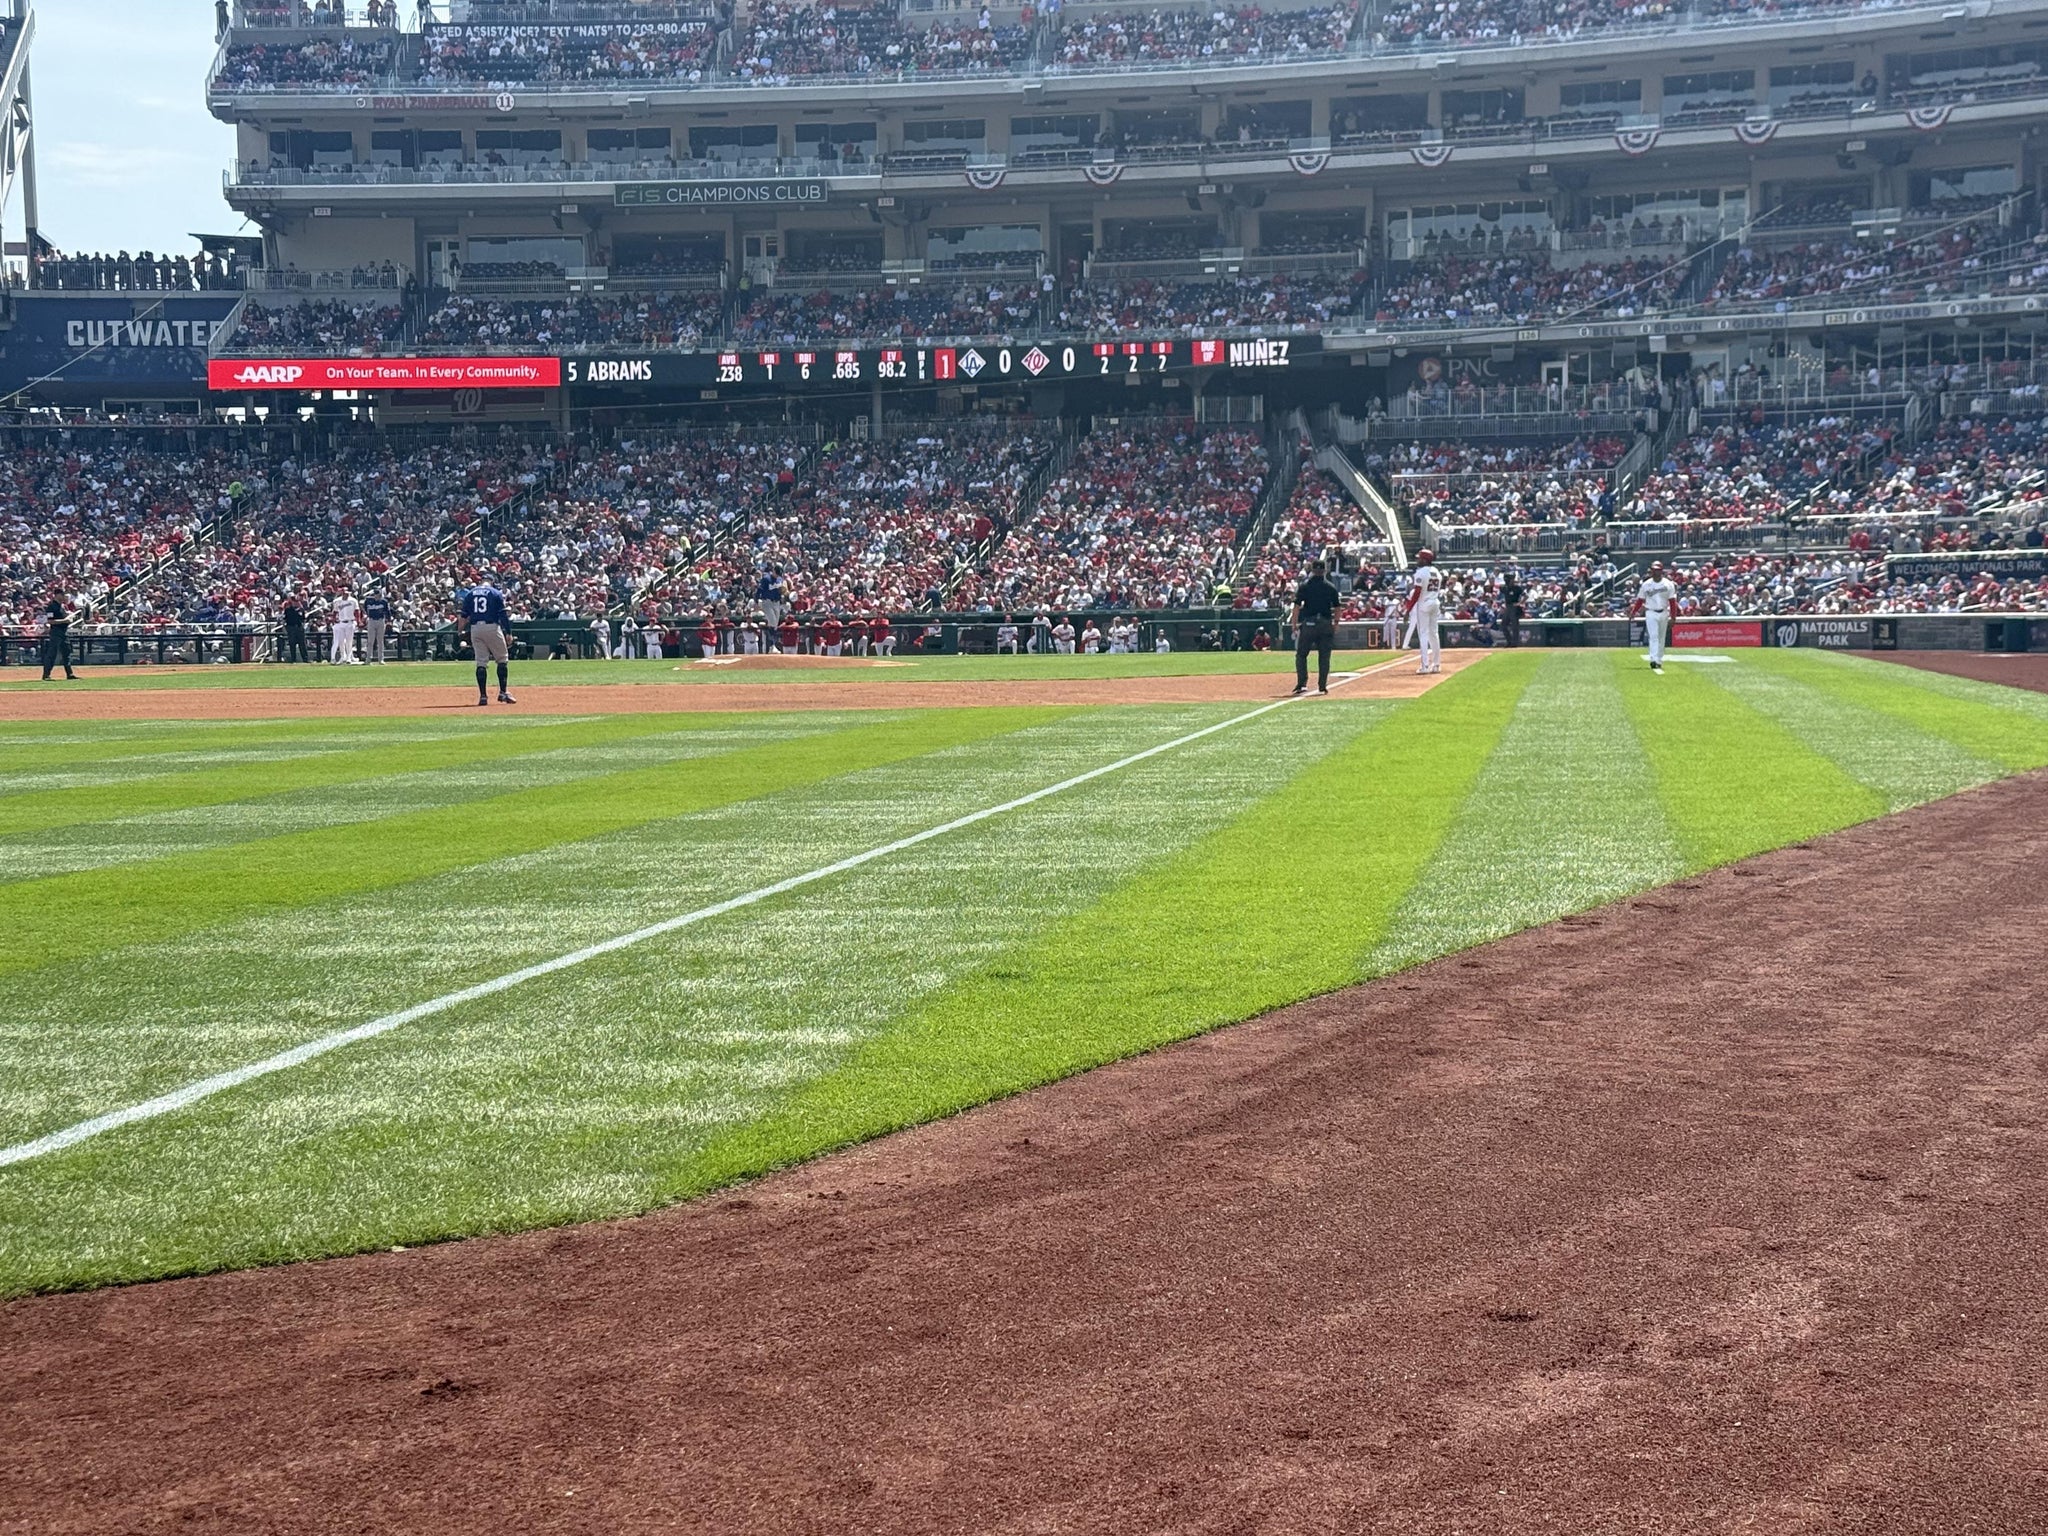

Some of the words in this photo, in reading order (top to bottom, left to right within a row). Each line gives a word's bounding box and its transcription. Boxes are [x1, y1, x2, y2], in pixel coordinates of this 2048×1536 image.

[542, 25, 571, 37] TEXT
[616, 24, 631, 36] TO
[499, 95, 512, 108] 11
[666, 186, 770, 202] CHAMPIONS
[775, 186, 821, 201] CLUB
[764, 354, 775, 364] HR
[838, 352, 853, 362] OPS
[887, 351, 897, 361] EV
[1063, 347, 1075, 371] 0
[1230, 338, 1289, 367] NUÑEZ
[878, 361, 907, 378] 98.2
[941, 355, 949, 374] 1
[999, 350, 1011, 373] 0
[1101, 356, 1109, 374] 2
[1129, 355, 1138, 373] 2
[1158, 354, 1167, 372] 2
[1447, 358, 1499, 378] PNC
[234, 366, 303, 383] AARP
[326, 367, 344, 378] On
[346, 367, 374, 378] Your
[376, 366, 413, 378] Team.
[416, 366, 428, 377] In
[430, 366, 464, 380] Every
[466, 365, 540, 380] Community.
[568, 361, 578, 381] 5
[587, 361, 652, 381] ABRAMS
[716, 366, 743, 382] .238
[766, 364, 773, 380] 1
[801, 363, 810, 380] 6
[832, 362, 860, 379] .685
[1962, 561, 2013, 573] NATIONALS
[474, 597, 487, 613] 13
[1800, 621, 1868, 633] NATIONALS
[1818, 635, 1848, 646] PARK
